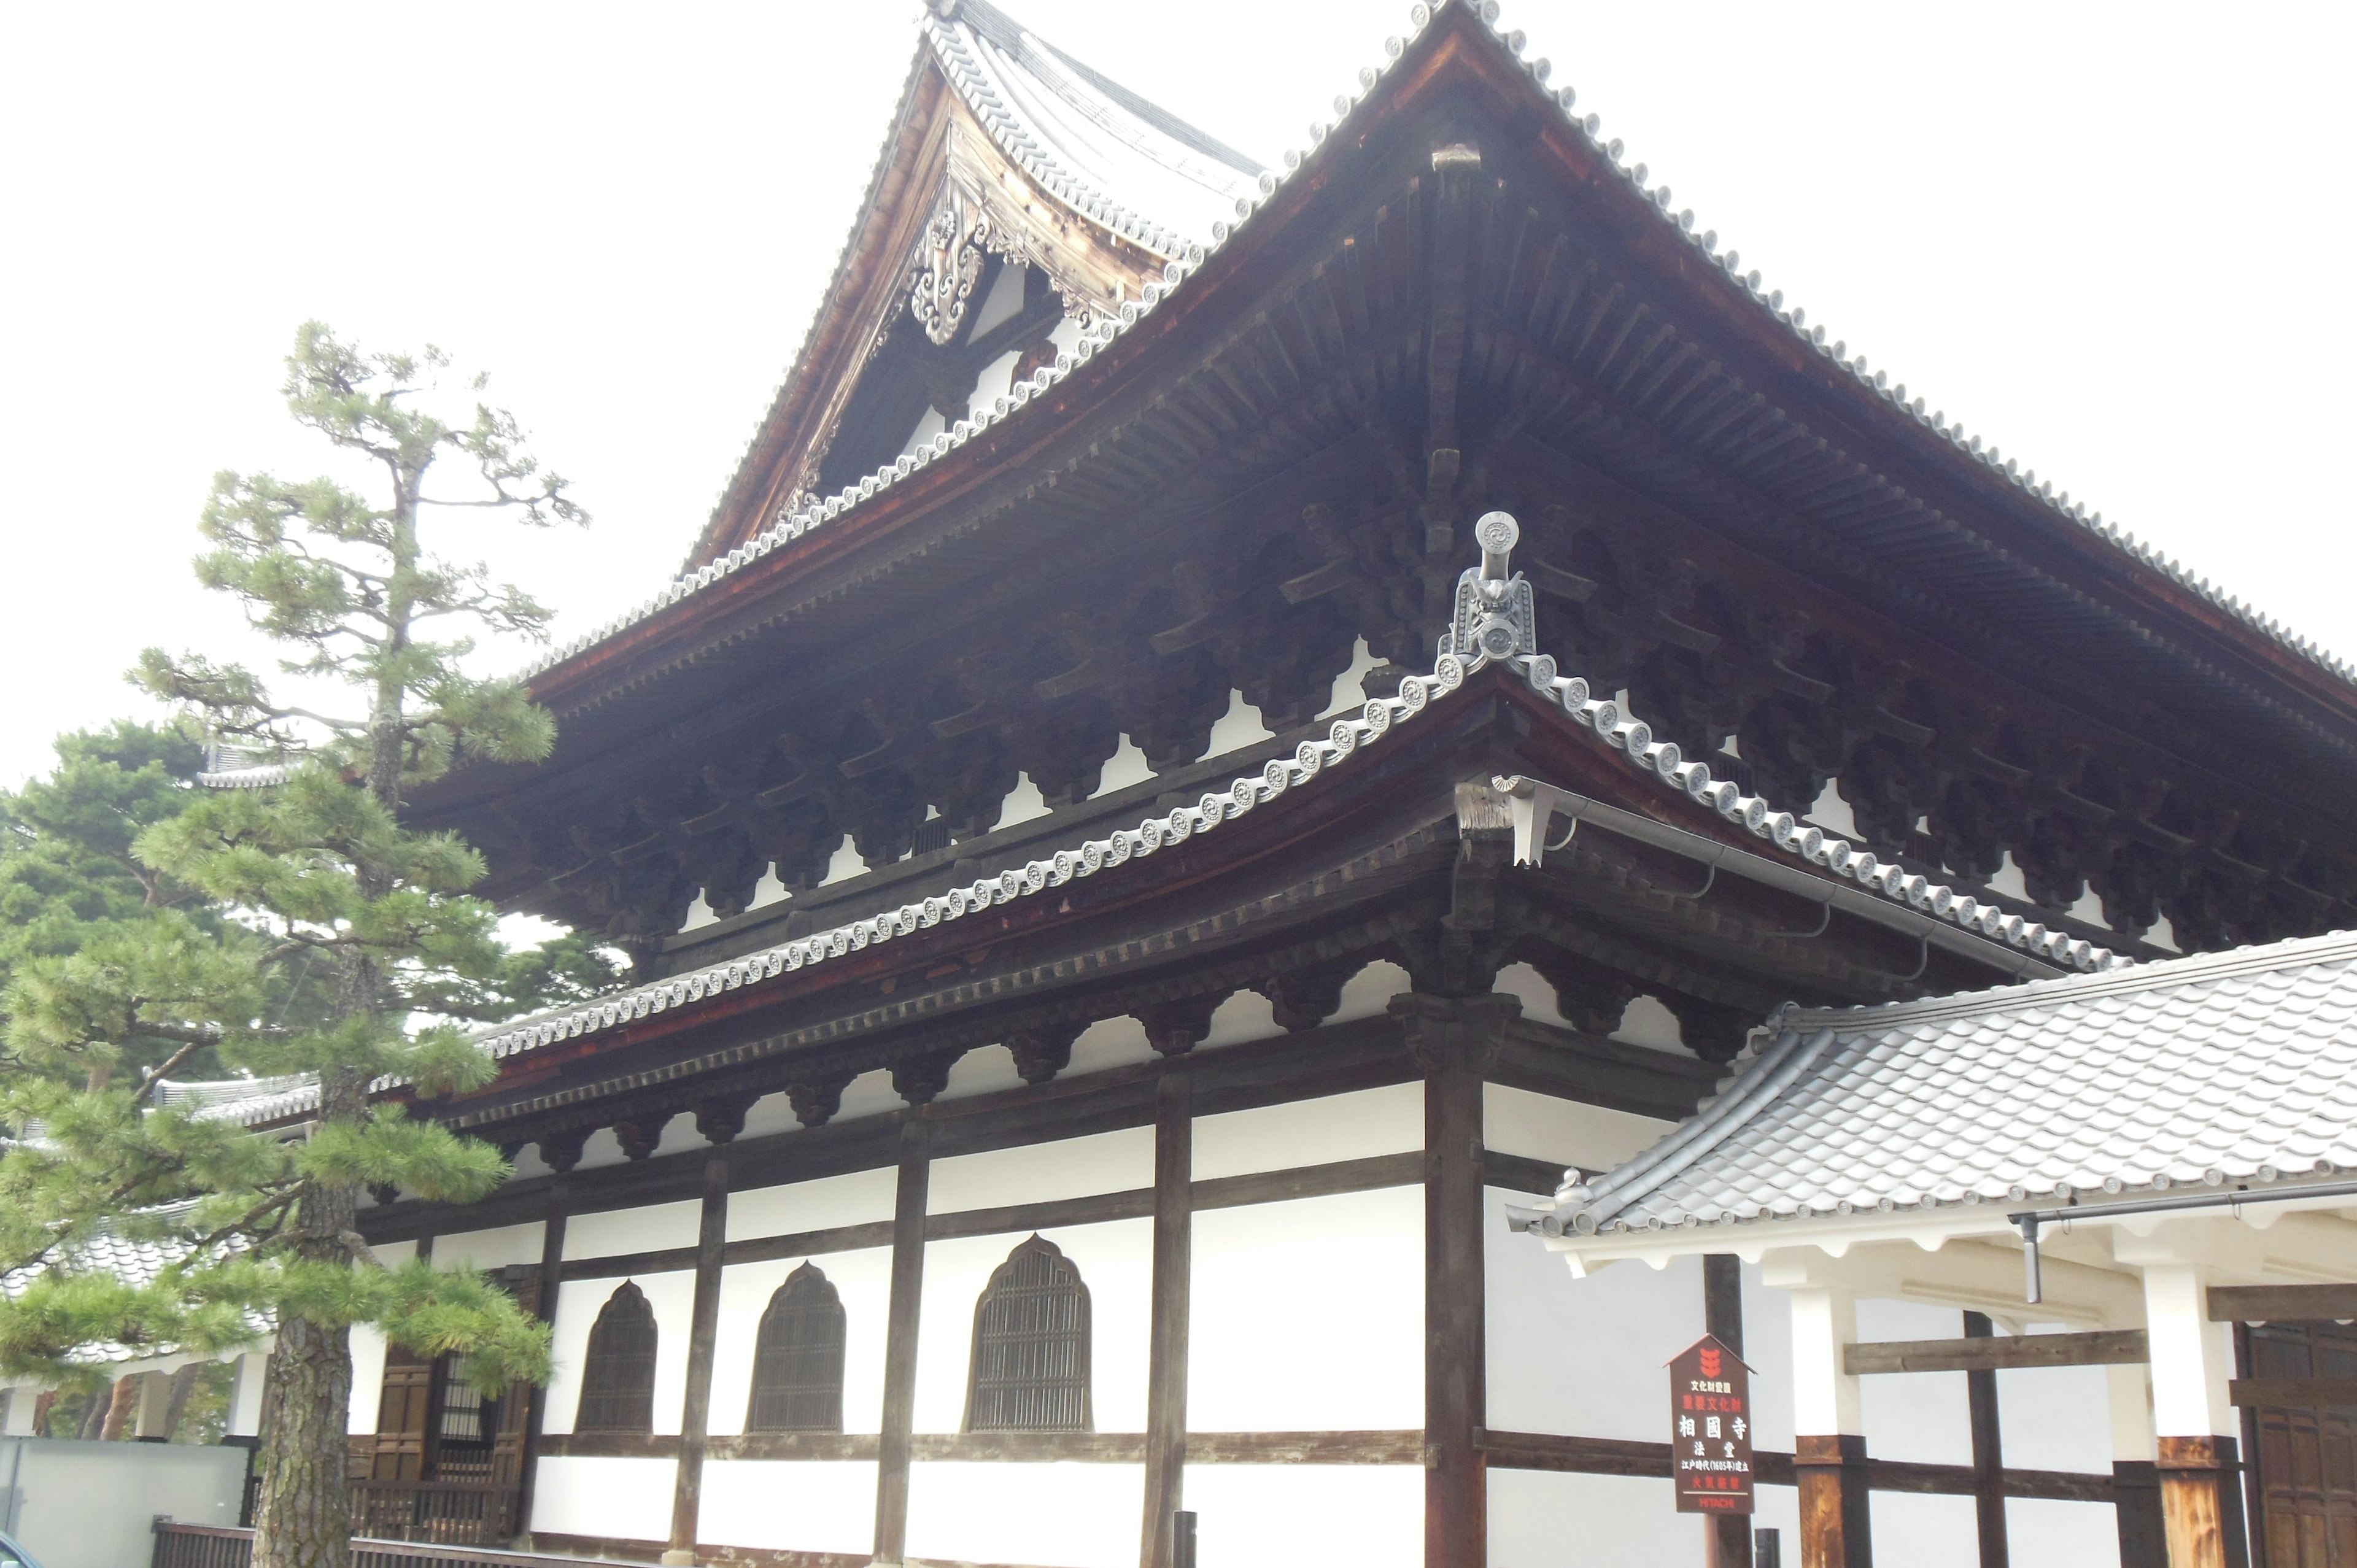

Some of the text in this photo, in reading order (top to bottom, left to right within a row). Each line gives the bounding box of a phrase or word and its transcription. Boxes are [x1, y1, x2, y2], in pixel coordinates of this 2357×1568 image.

[1679, 1415, 1747, 1440] 相國寺
[1694, 1441, 1735, 1458] 法堂
[1699, 1497, 1735, 1508] HITACHI
